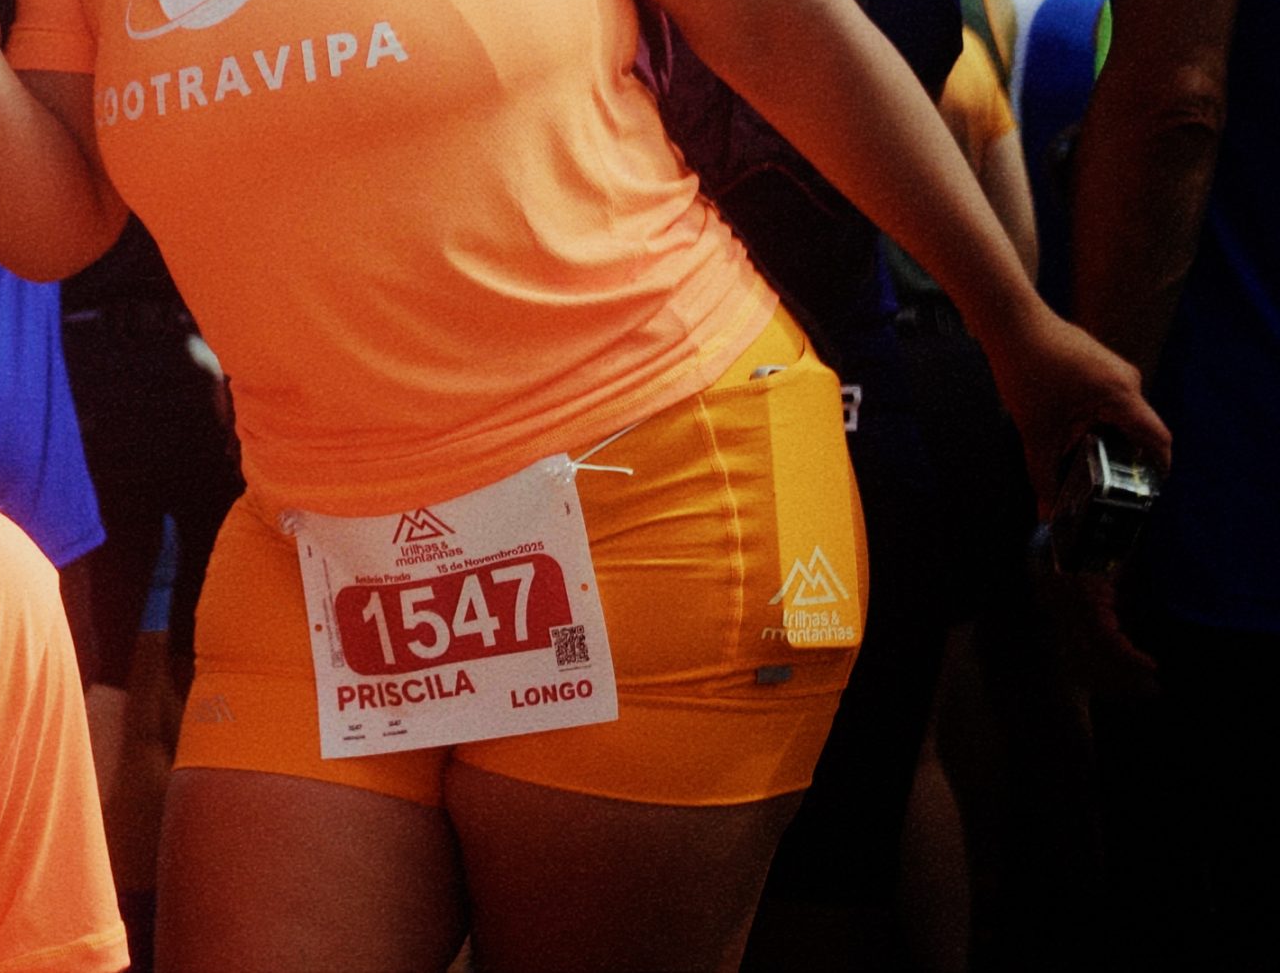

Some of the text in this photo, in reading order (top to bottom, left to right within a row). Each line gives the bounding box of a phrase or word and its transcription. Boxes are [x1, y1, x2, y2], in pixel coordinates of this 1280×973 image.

[96, 21, 409, 127] OOTRAVIPA
[395, 547, 463, 567] montanhas
[400, 542, 439, 557] trilhas
[436, 563, 449, 574] 15
[450, 561, 463, 571] de
[361, 561, 536, 665] 1547
[782, 609, 830, 628] trilhas
[760, 626, 855, 644] montanhas
[336, 669, 477, 712] PRISCILA
[510, 679, 593, 709] LONGO
